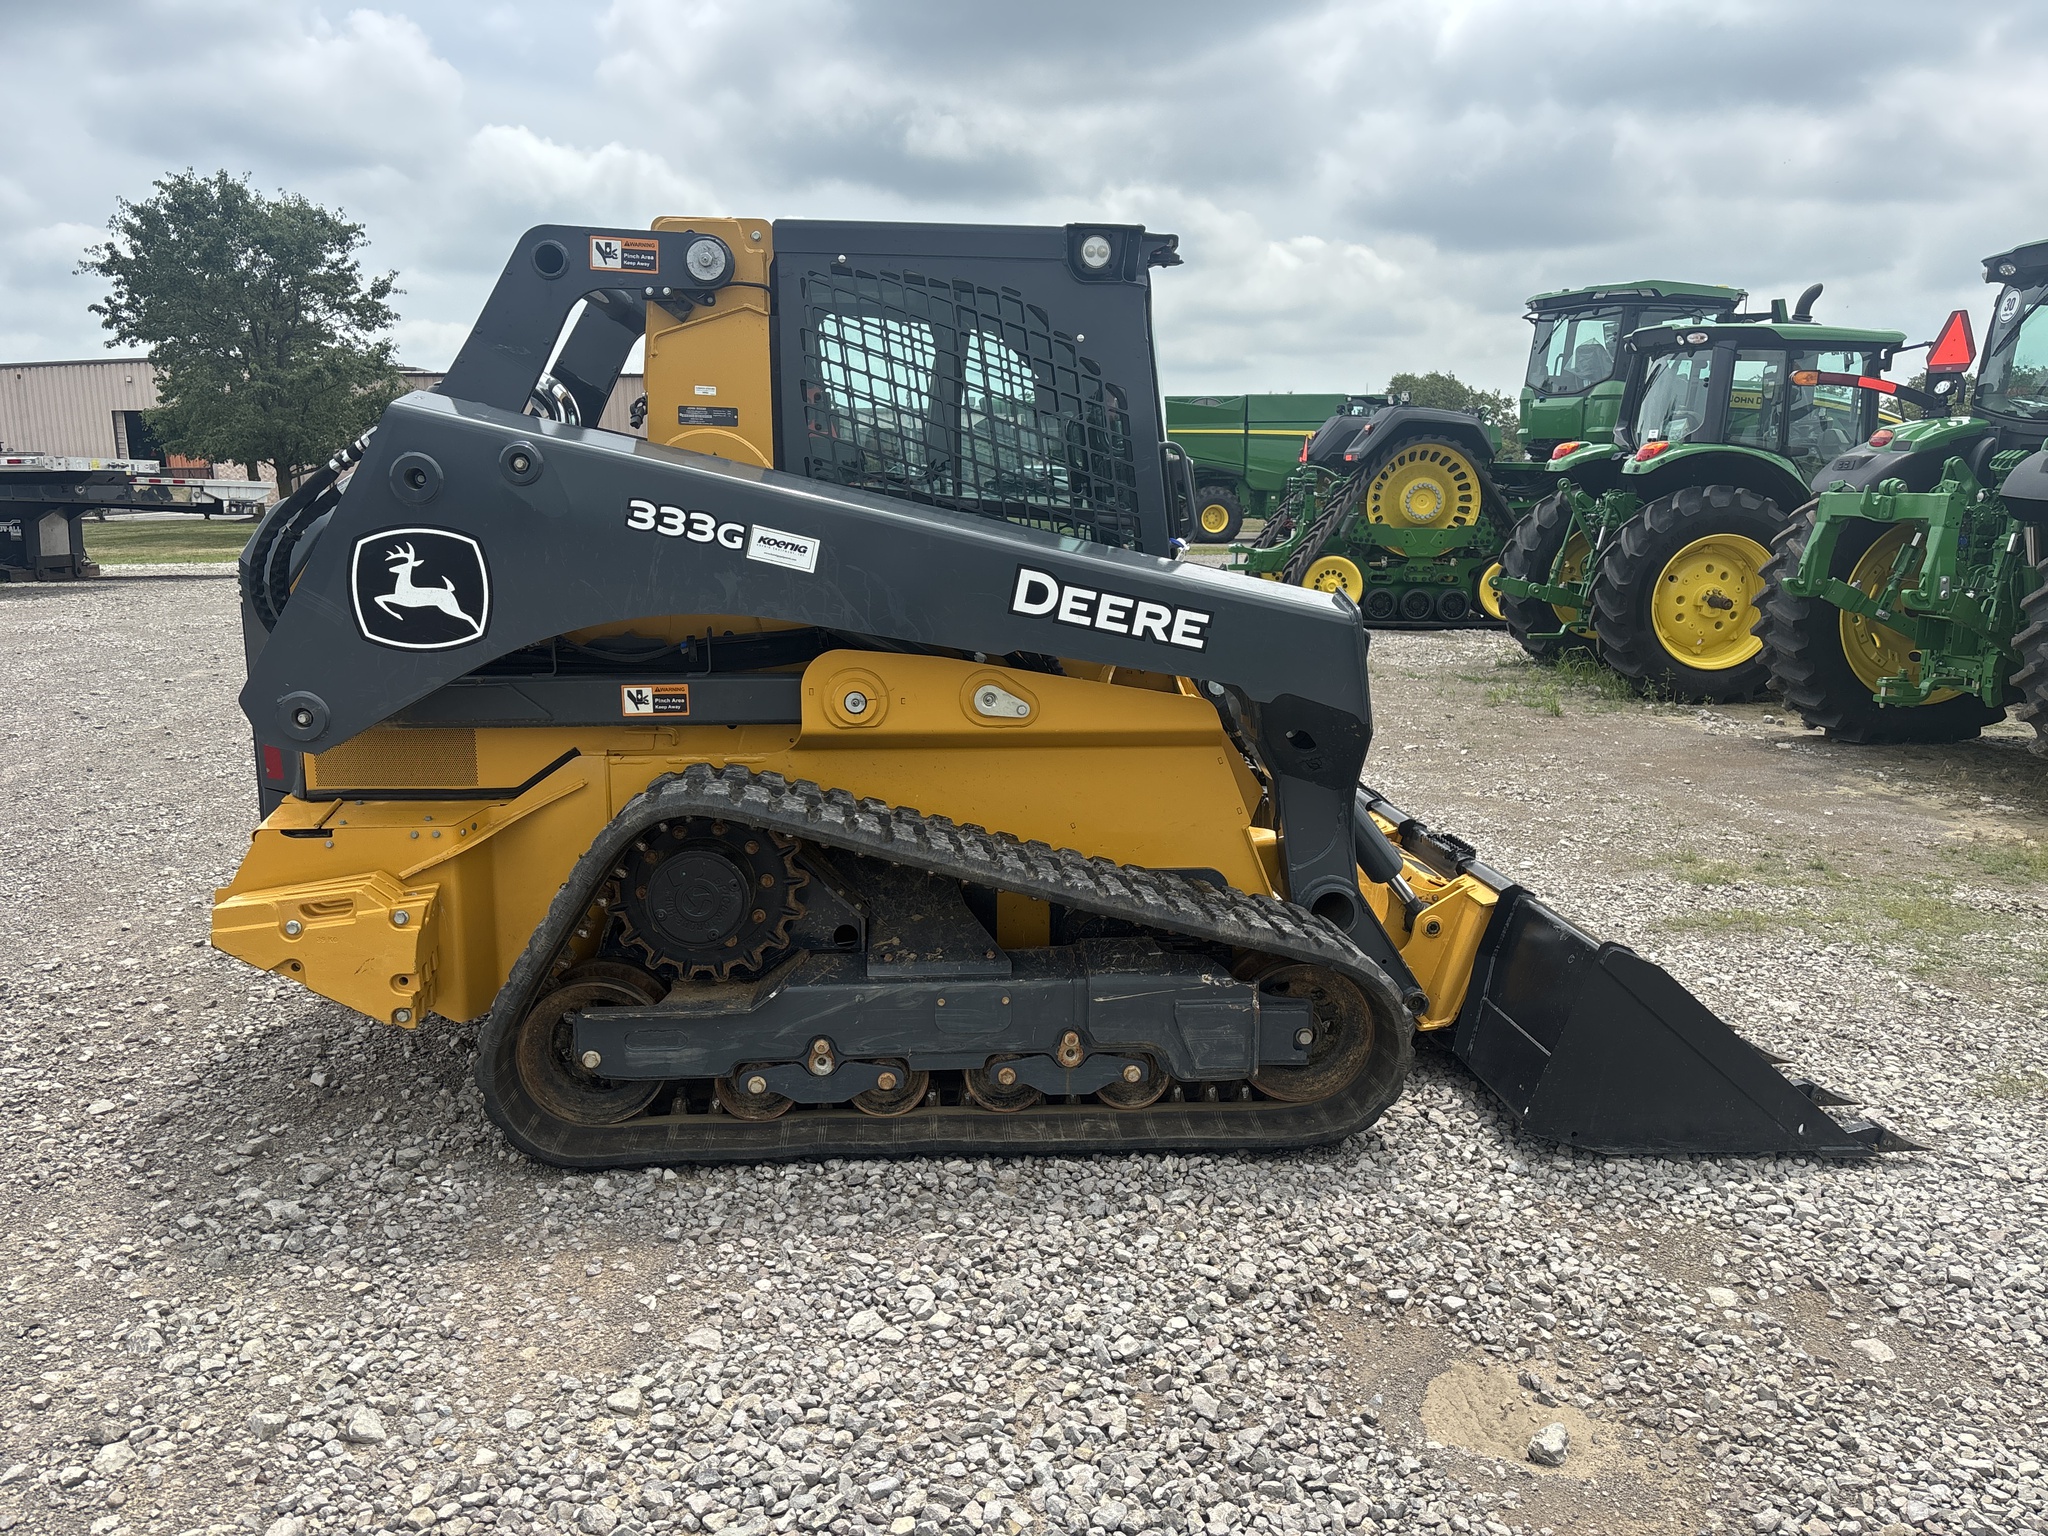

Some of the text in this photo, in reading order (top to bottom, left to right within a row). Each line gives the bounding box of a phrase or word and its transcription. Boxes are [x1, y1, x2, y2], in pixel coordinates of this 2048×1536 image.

[2004, 297, 2016, 312] 30
[626, 499, 746, 551] 333G
[1012, 568, 1210, 649] DEERE
